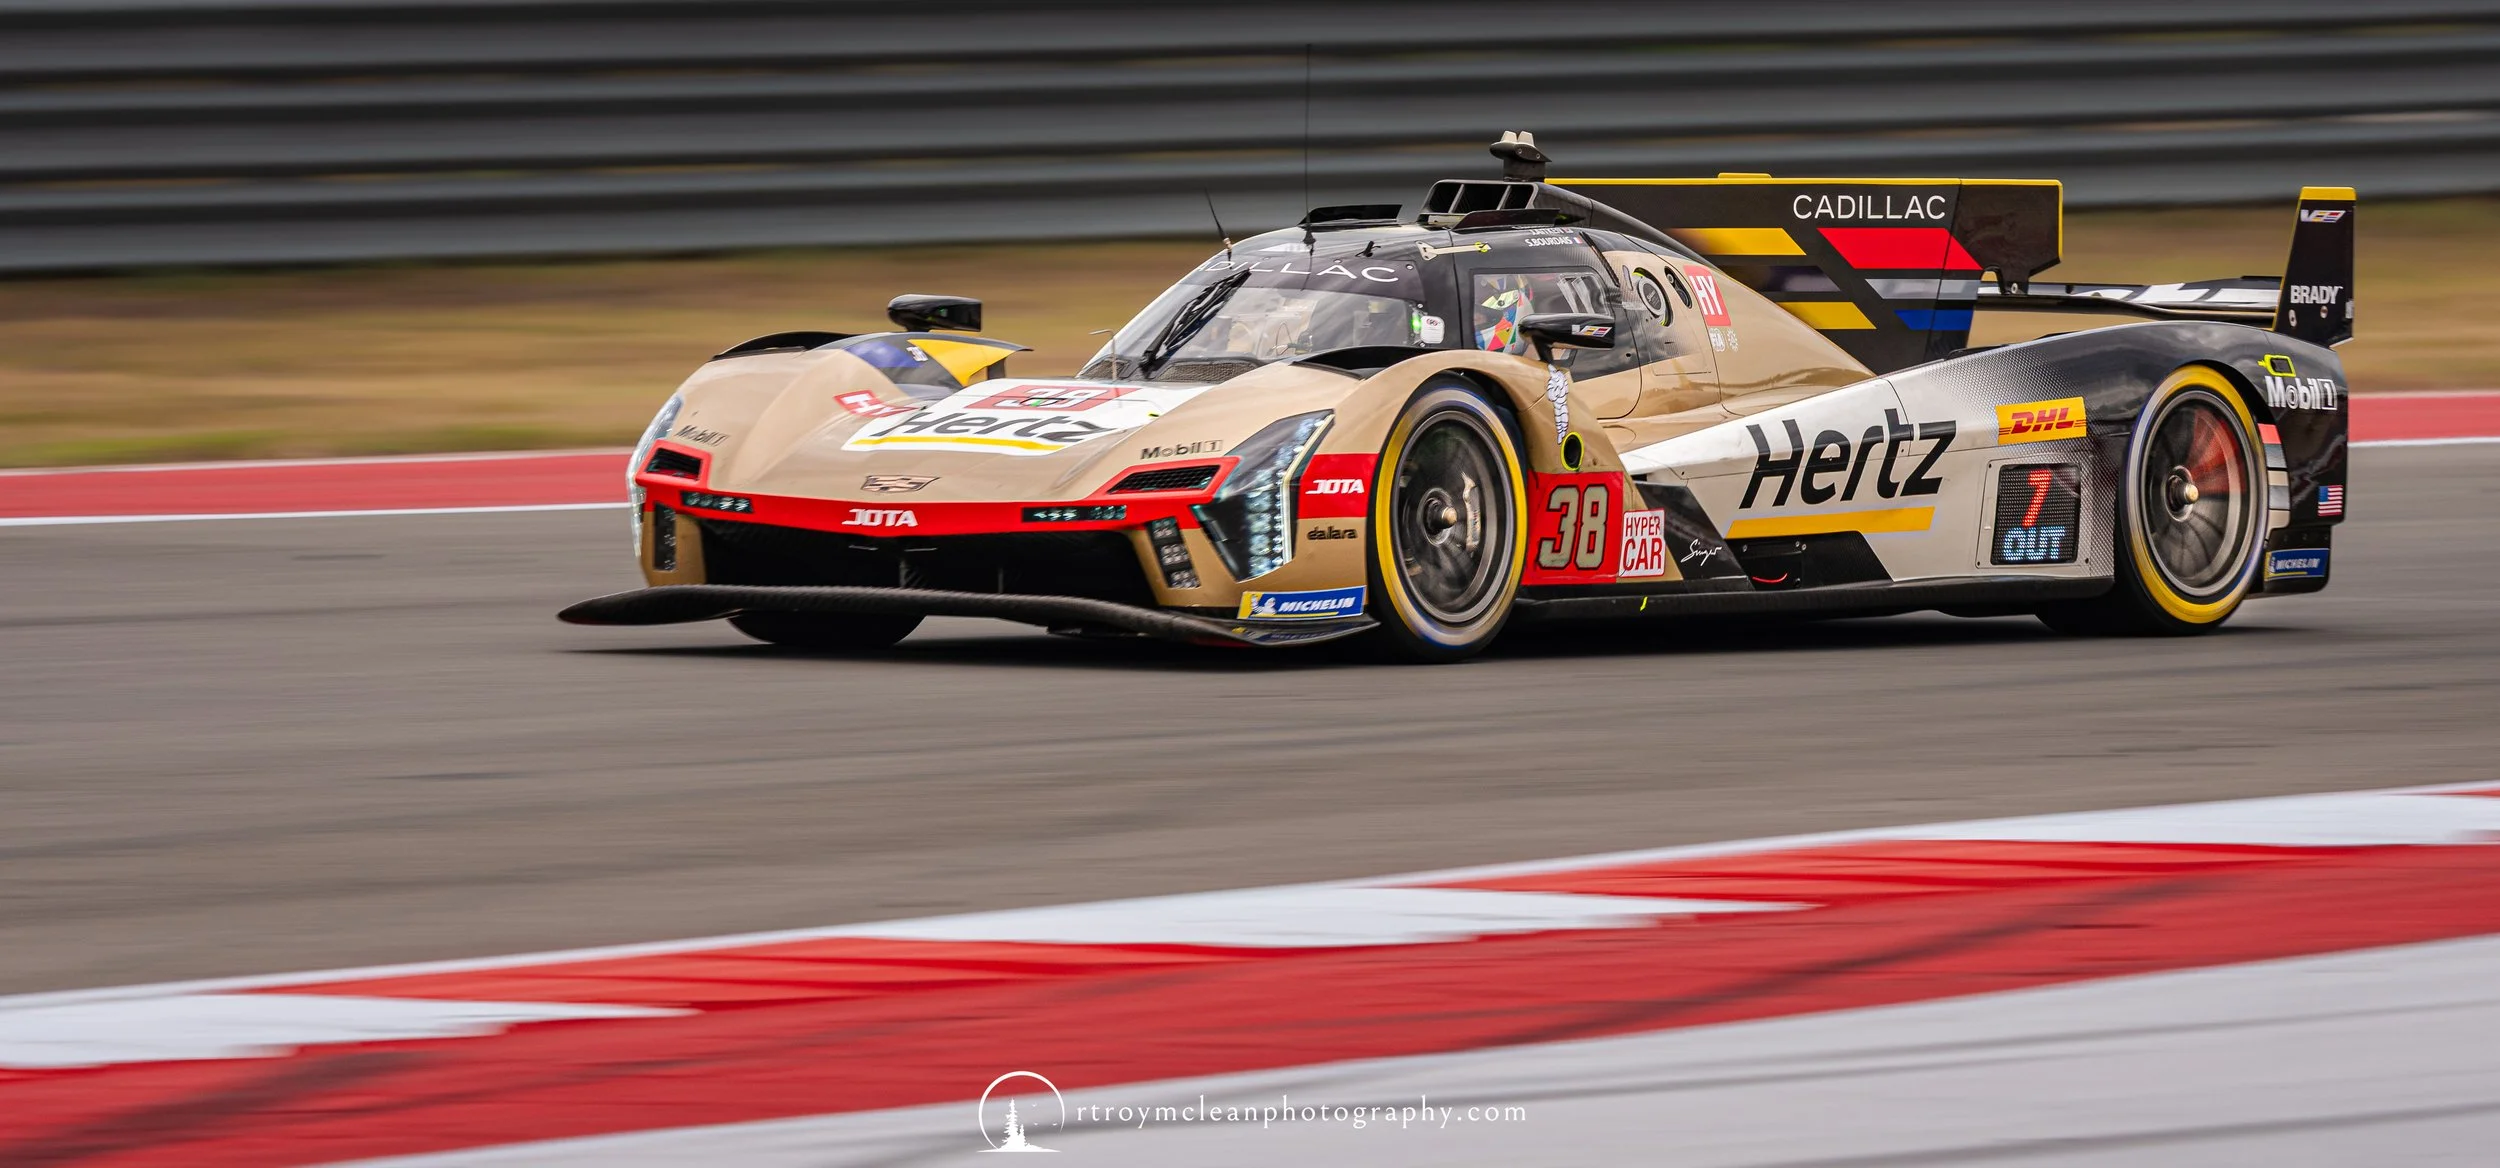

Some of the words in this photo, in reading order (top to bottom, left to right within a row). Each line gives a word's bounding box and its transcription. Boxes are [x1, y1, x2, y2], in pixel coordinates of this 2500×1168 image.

[1793, 195, 1946, 220] CADILLAC
[1689, 275, 1723, 316] HY
[2290, 285, 2340, 305] BRADY
[869, 412, 1119, 442] Hertz
[2011, 407, 2075, 434] DHL
[1739, 408, 1957, 510] Hertz
[1305, 479, 1365, 495] JOTA
[2021, 469, 2053, 529] 7
[842, 508, 919, 528] JOTA
[1536, 484, 1610, 570] 38
[1625, 513, 1661, 537] HYPER
[1623, 538, 1663, 572] CAR
[2003, 525, 2066, 560] OUT
[2276, 558, 2320, 570] MICHELIN
[1277, 596, 1356, 613] MICHELIN
